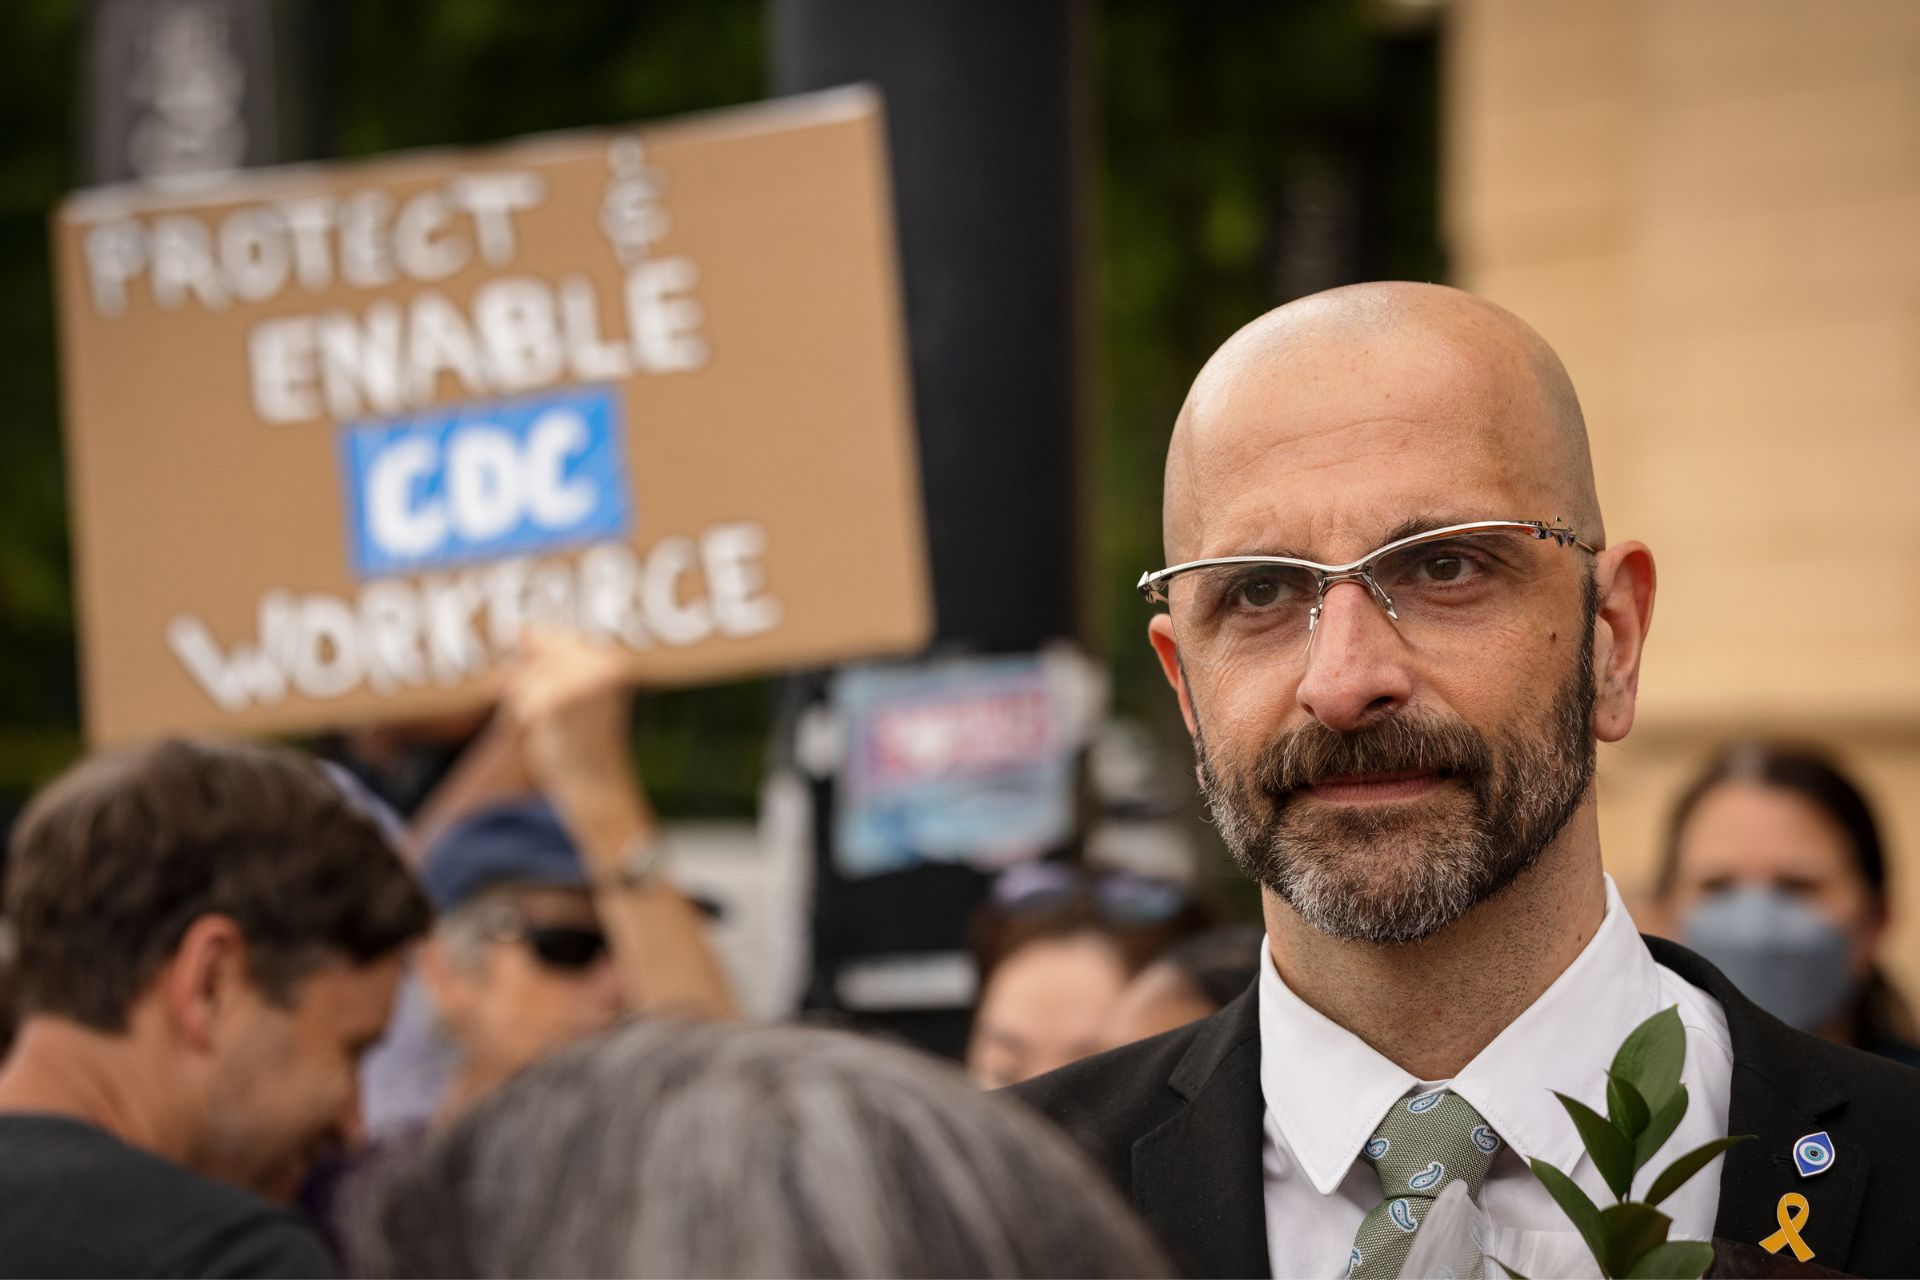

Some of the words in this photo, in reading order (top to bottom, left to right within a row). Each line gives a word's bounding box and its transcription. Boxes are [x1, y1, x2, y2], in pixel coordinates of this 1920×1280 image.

[84, 173, 546, 320] PROTECT
[249, 257, 709, 423] ENABLE
[366, 411, 600, 557] CDC
